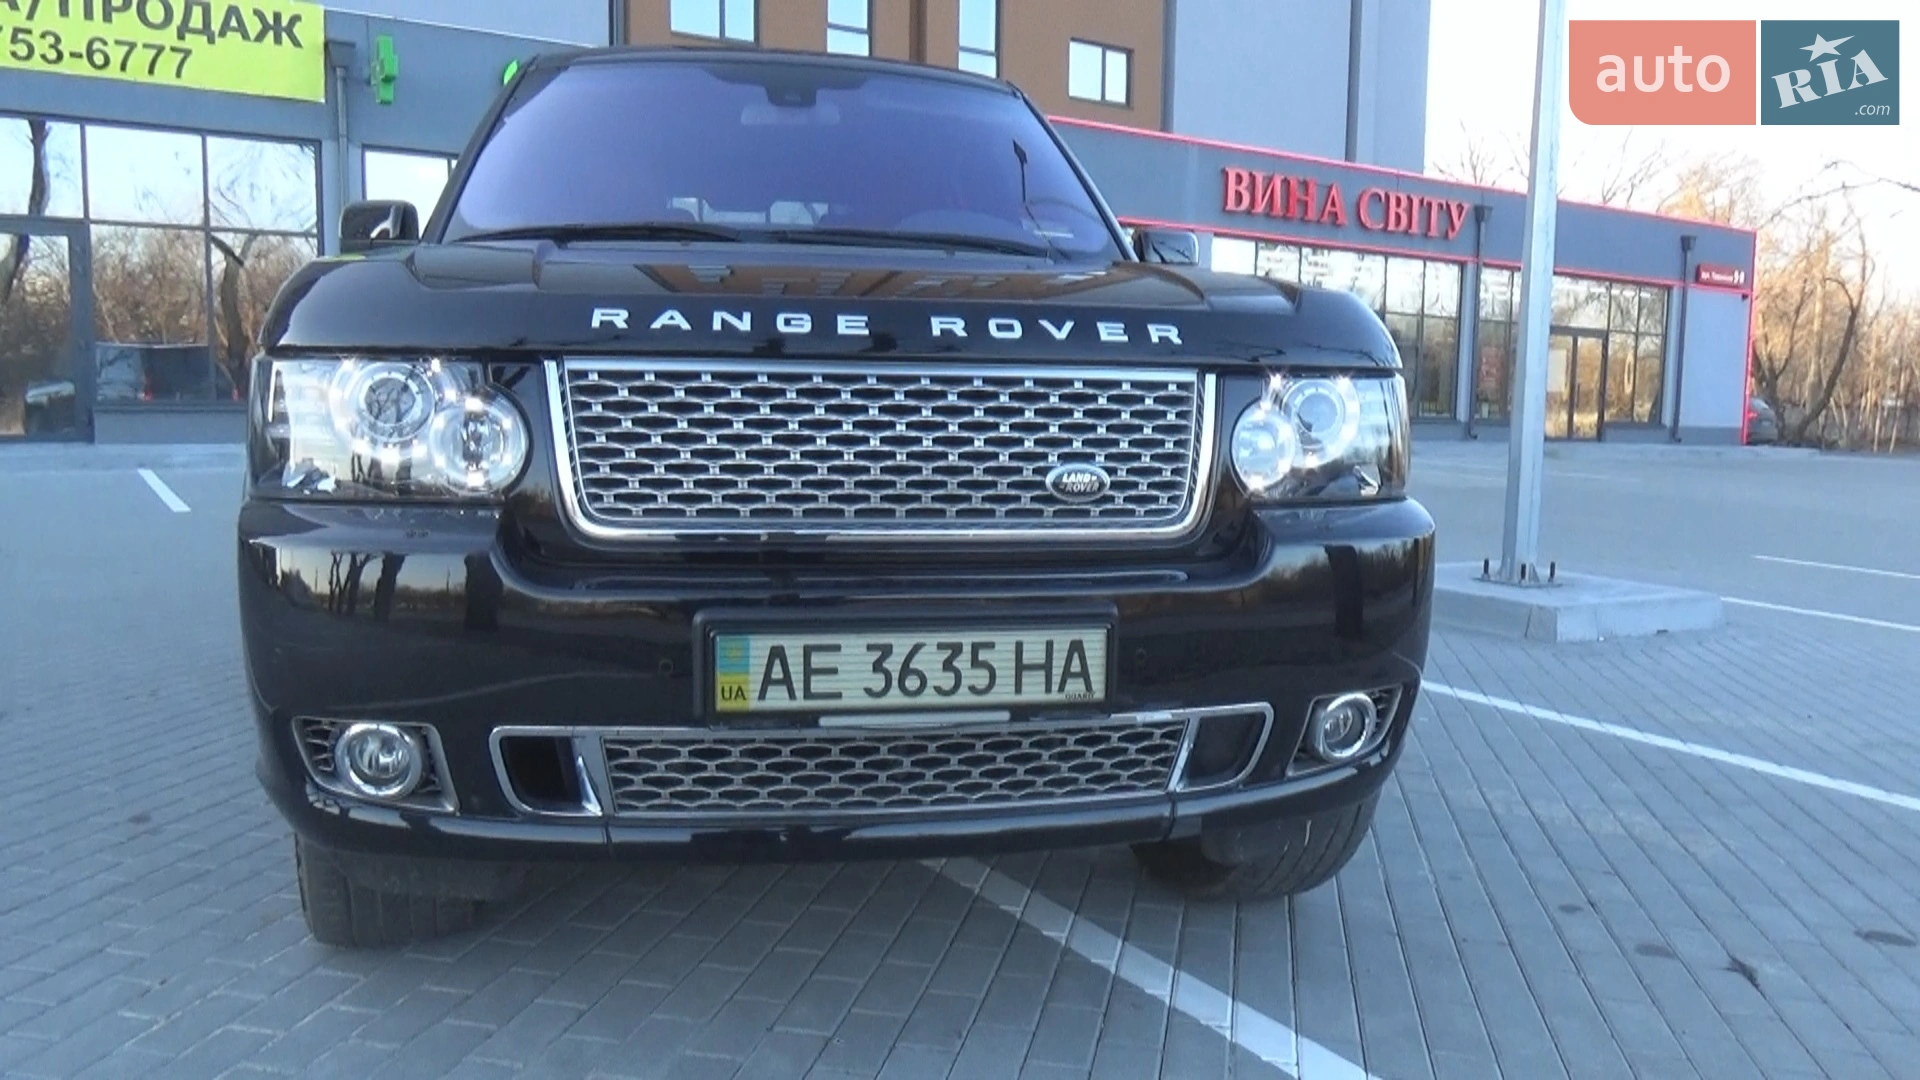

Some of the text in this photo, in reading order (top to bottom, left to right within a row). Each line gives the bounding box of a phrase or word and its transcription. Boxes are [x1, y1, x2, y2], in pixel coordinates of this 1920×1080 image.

[0, 0, 303, 48] /ПРОДАЖ
[0, 25, 193, 79] 53-6777
[1223, 167, 1470, 239] ВИНА СВІТУ
[591, 307, 1183, 345] RANGE ROVER
[1062, 472, 1091, 483] LAND
[720, 685, 747, 701] UA
[757, 639, 1094, 701] AE 3635 HA
